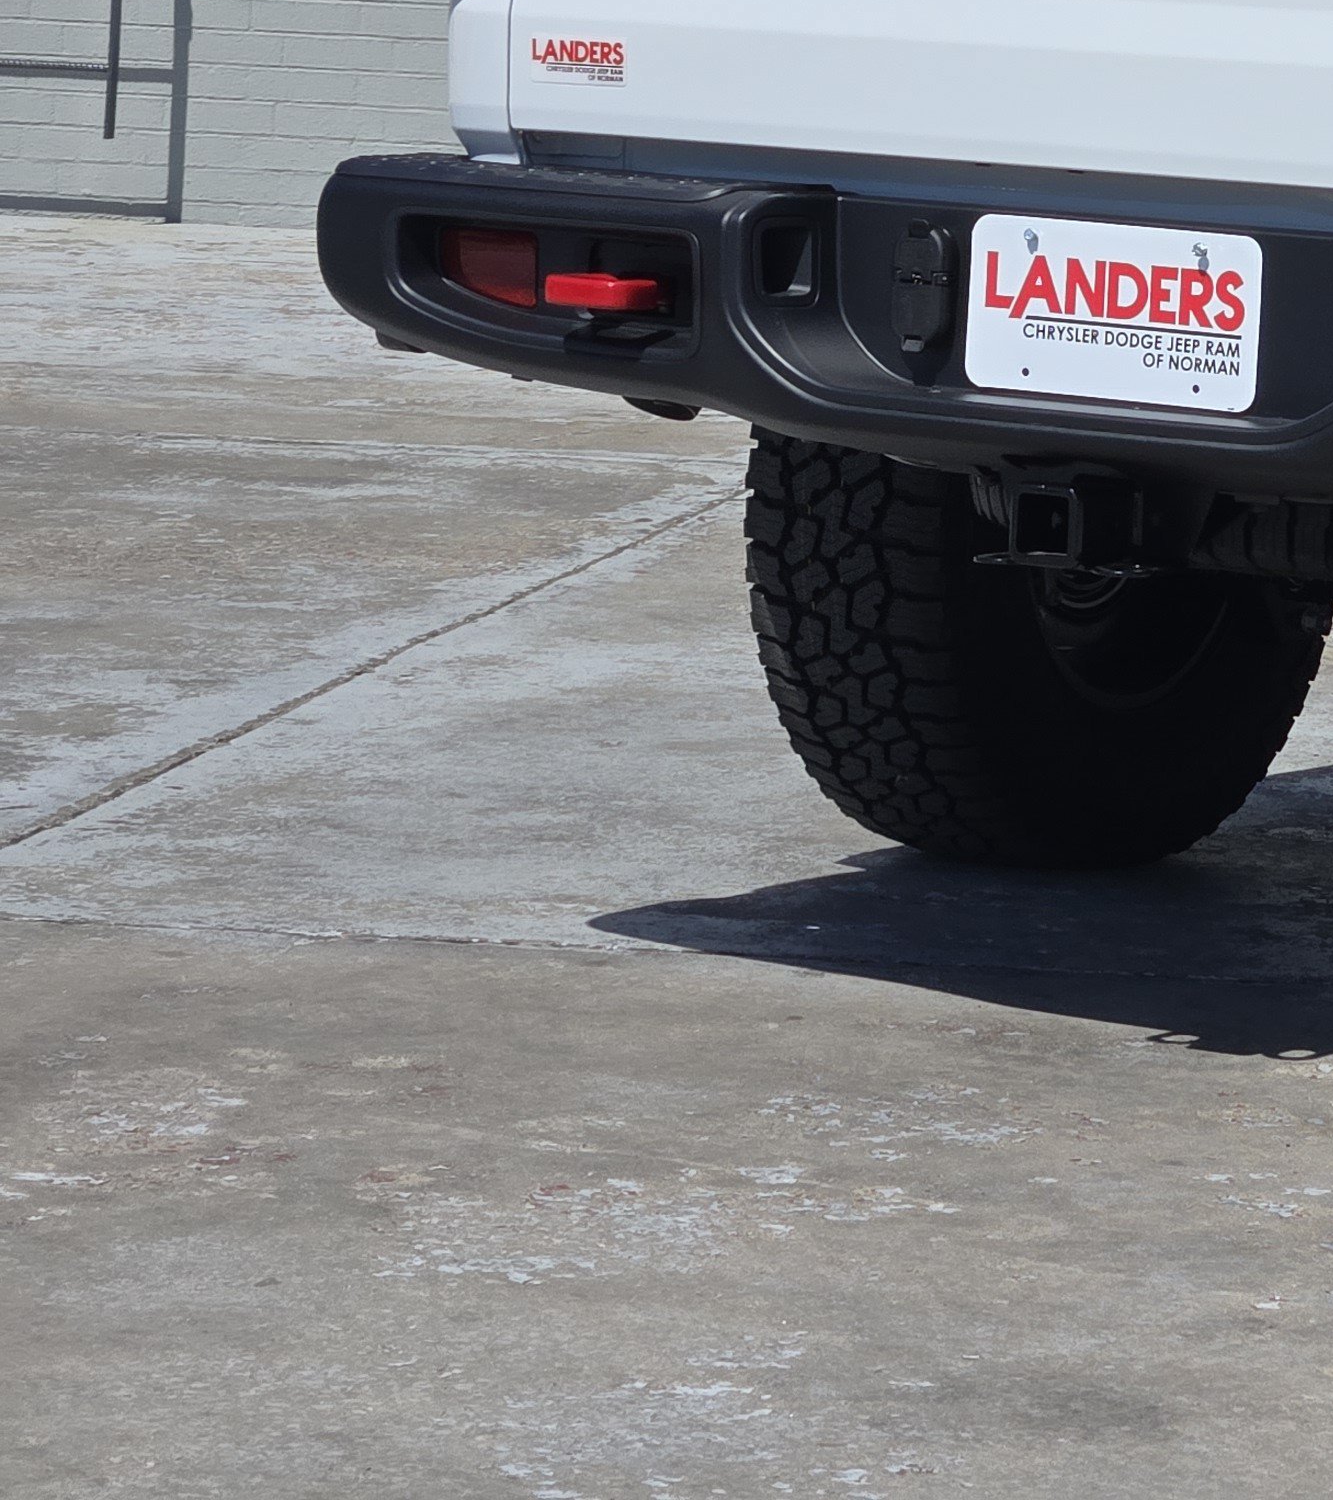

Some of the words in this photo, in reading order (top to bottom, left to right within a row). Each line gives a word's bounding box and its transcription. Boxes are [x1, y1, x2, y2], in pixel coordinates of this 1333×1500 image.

[531, 38, 624, 65] LANDERS
[984, 250, 1246, 332] LANDERS
[1022, 322, 1100, 345] CHRYSLER
[1104, 330, 1163, 351] DODGE
[1166, 336, 1201, 354] JEEP
[1205, 340, 1241, 358] RAM
[1142, 352, 1164, 369] OF
[1168, 354, 1241, 377] NORMAN
